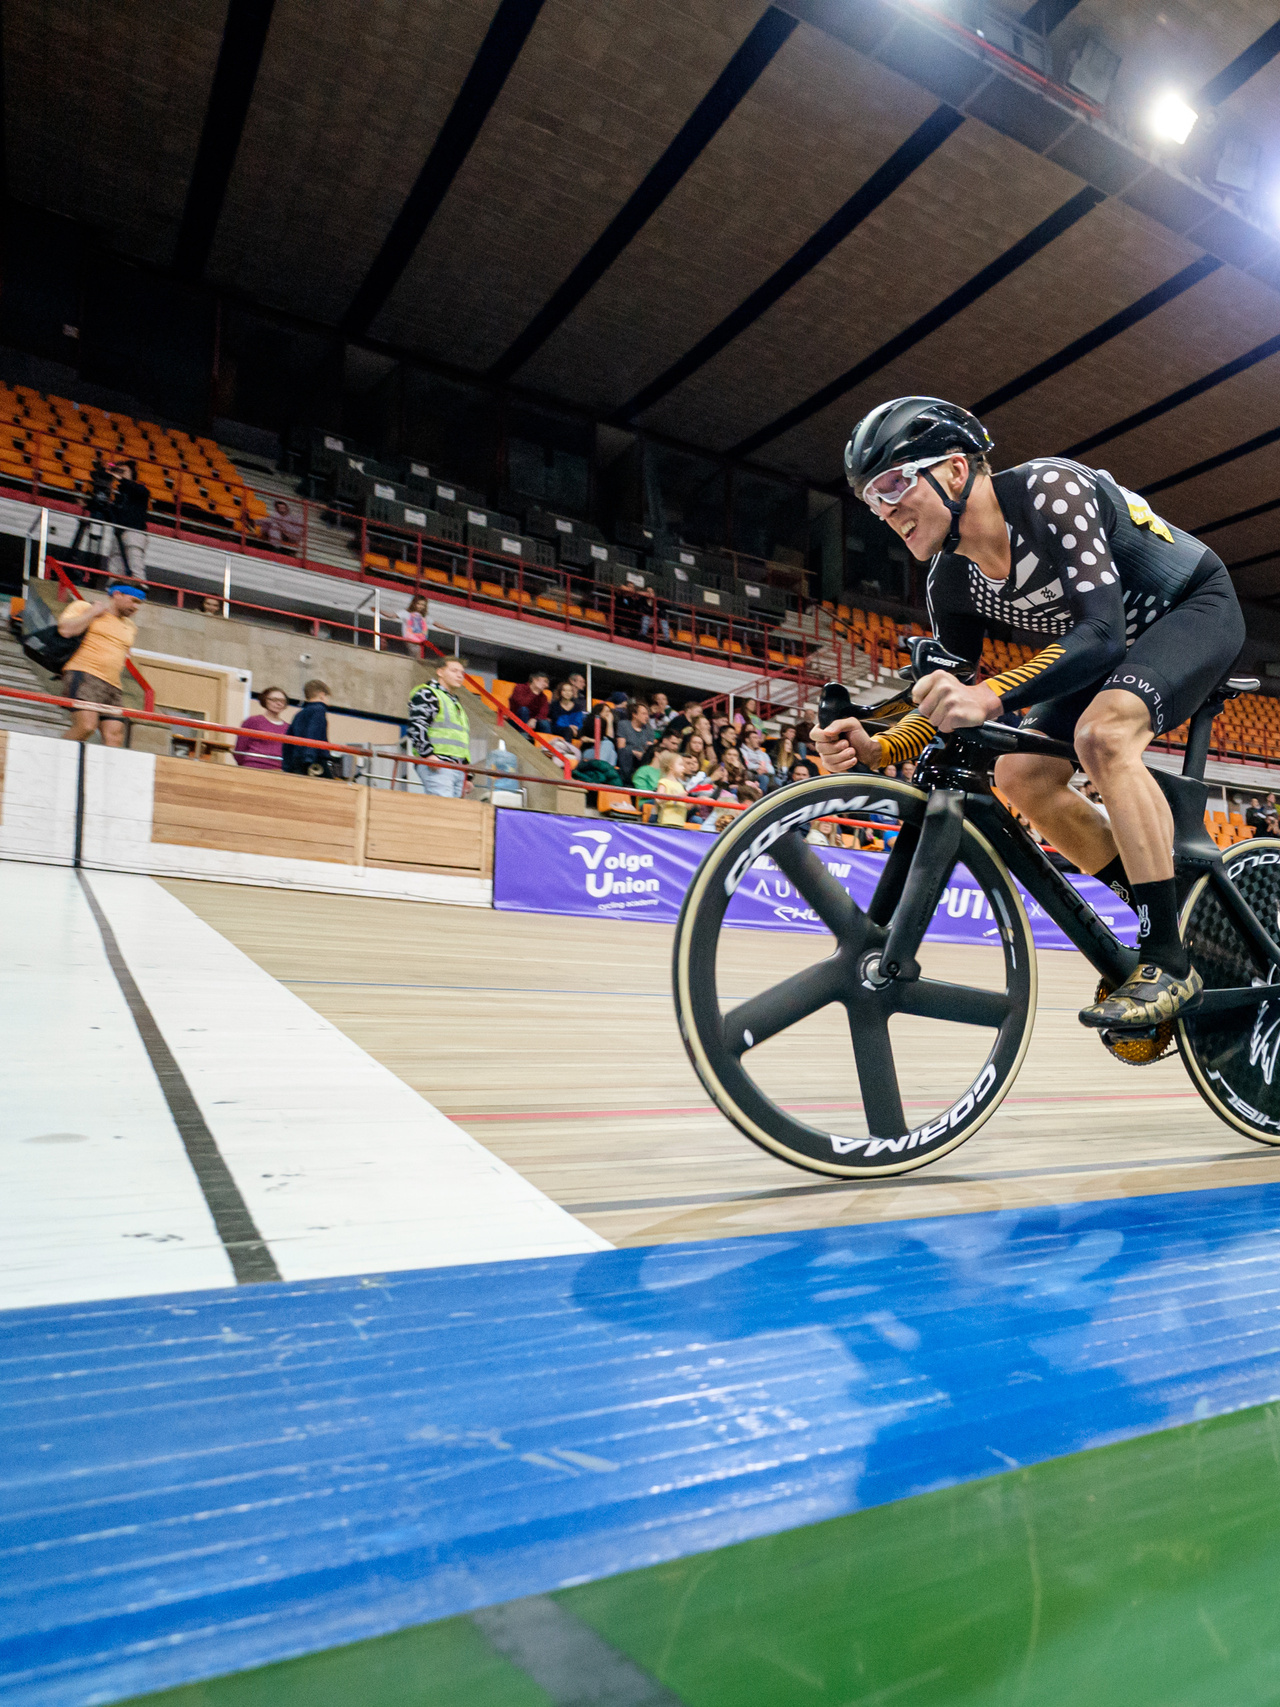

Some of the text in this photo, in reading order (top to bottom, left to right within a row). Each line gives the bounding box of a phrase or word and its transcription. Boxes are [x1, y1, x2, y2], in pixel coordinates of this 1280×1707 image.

[926, 655, 959, 668] MOST
[569, 842, 655, 872] Volga
[724, 795, 900, 897] CORIMA
[585, 872, 660, 898] Union
[829, 1063, 997, 1157] CORIMA
